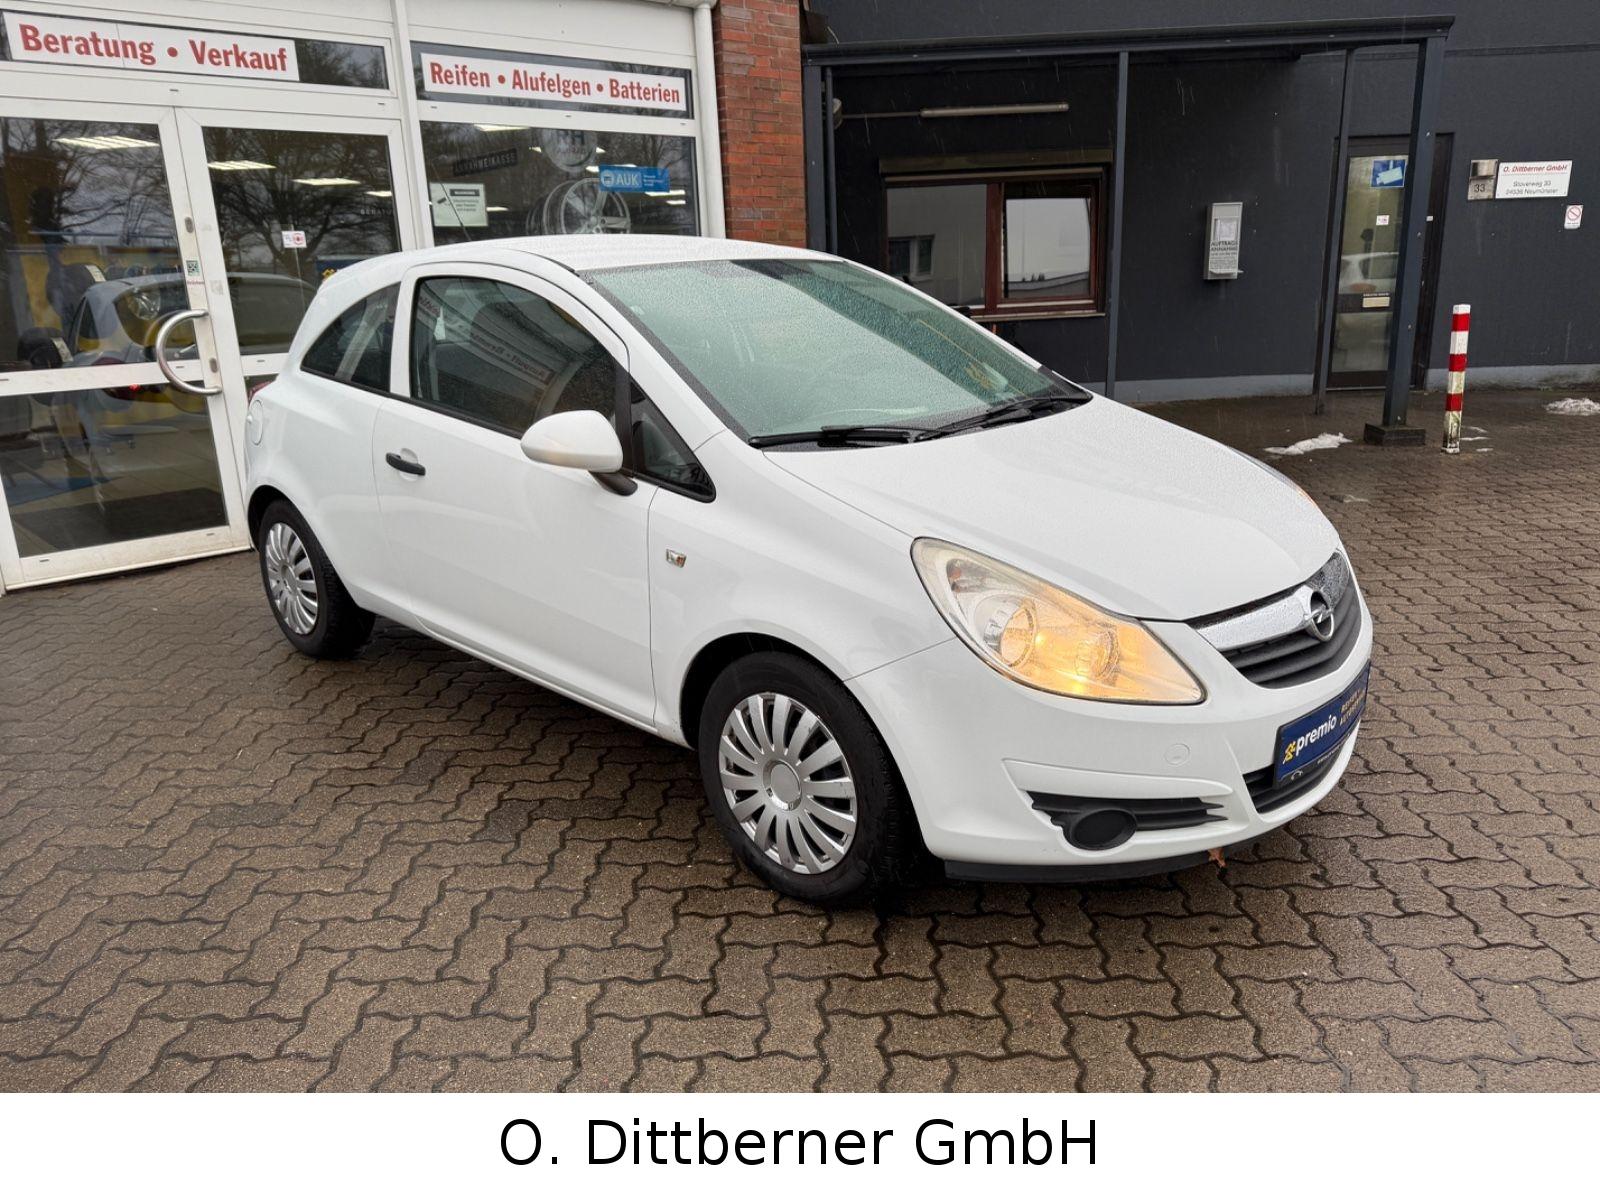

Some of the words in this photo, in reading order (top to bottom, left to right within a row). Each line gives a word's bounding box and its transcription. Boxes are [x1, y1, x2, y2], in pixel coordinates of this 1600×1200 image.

[19, 23, 156, 66] Beratung
[188, 39, 287, 72] Verkauf
[430, 62, 490, 88] Reifen
[512, 69, 591, 98] Alufelgen
[609, 78, 680, 104] Batterien
[616, 174, 639, 186] AUK
[1474, 184, 1486, 193] 33
[1295, 714, 1337, 757] premio
